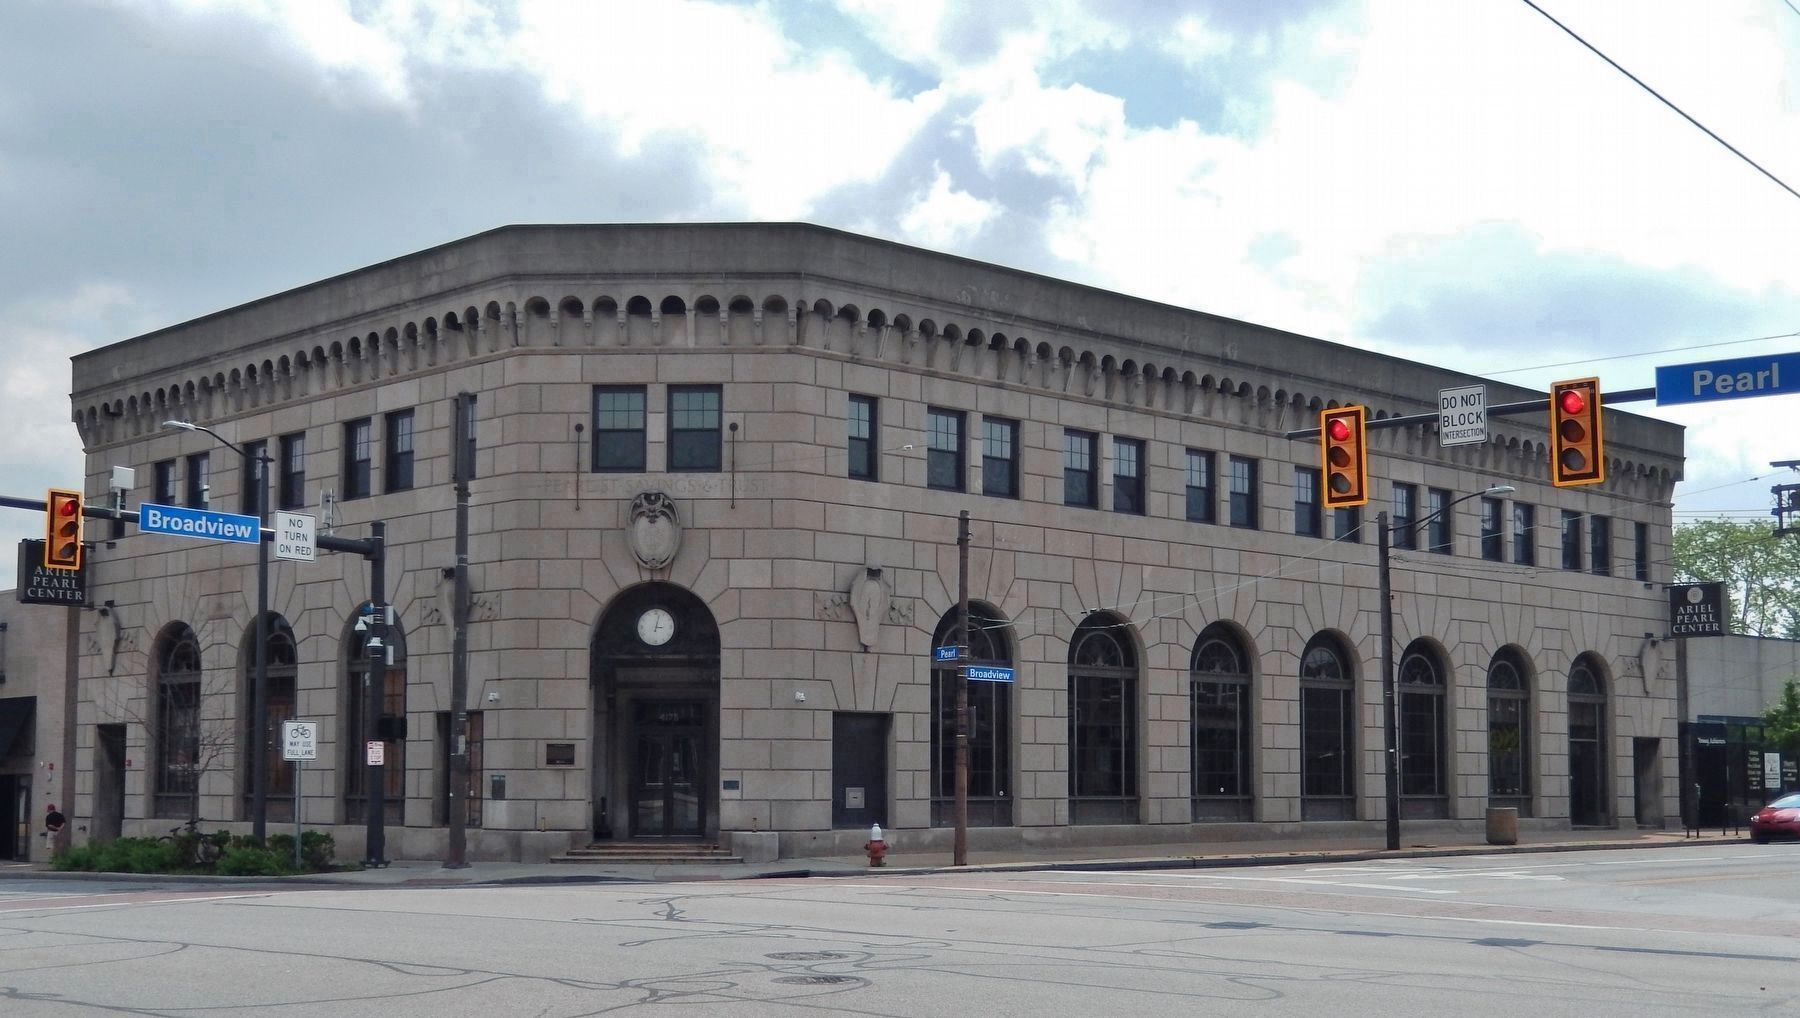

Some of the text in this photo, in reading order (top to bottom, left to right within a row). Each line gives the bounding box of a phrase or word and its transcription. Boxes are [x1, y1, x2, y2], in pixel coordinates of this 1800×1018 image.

[1693, 362, 1779, 396] Pearl
[1442, 393, 1482, 410] DO NOT
[1442, 411, 1483, 428] BLOCK
[1442, 428, 1484, 440] INTERSECTION
[625, 479, 698, 493] SAVINGS
[148, 509, 252, 539] Broadview
[288, 518, 304, 528] NO
[284, 530, 308, 542] TURN
[279, 543, 312, 556] ON RED
[34, 566, 78, 578] ARIEL
[33, 576, 79, 589] PEARL
[27, 587, 83, 600] CENTER
[1677, 604, 1714, 614] ARIEL
[1676, 613, 1715, 624] PEARL
[1672, 622, 1720, 633] CENTER
[940, 649, 956, 659] Pearl
[969, 668, 1011, 680] Broadview
